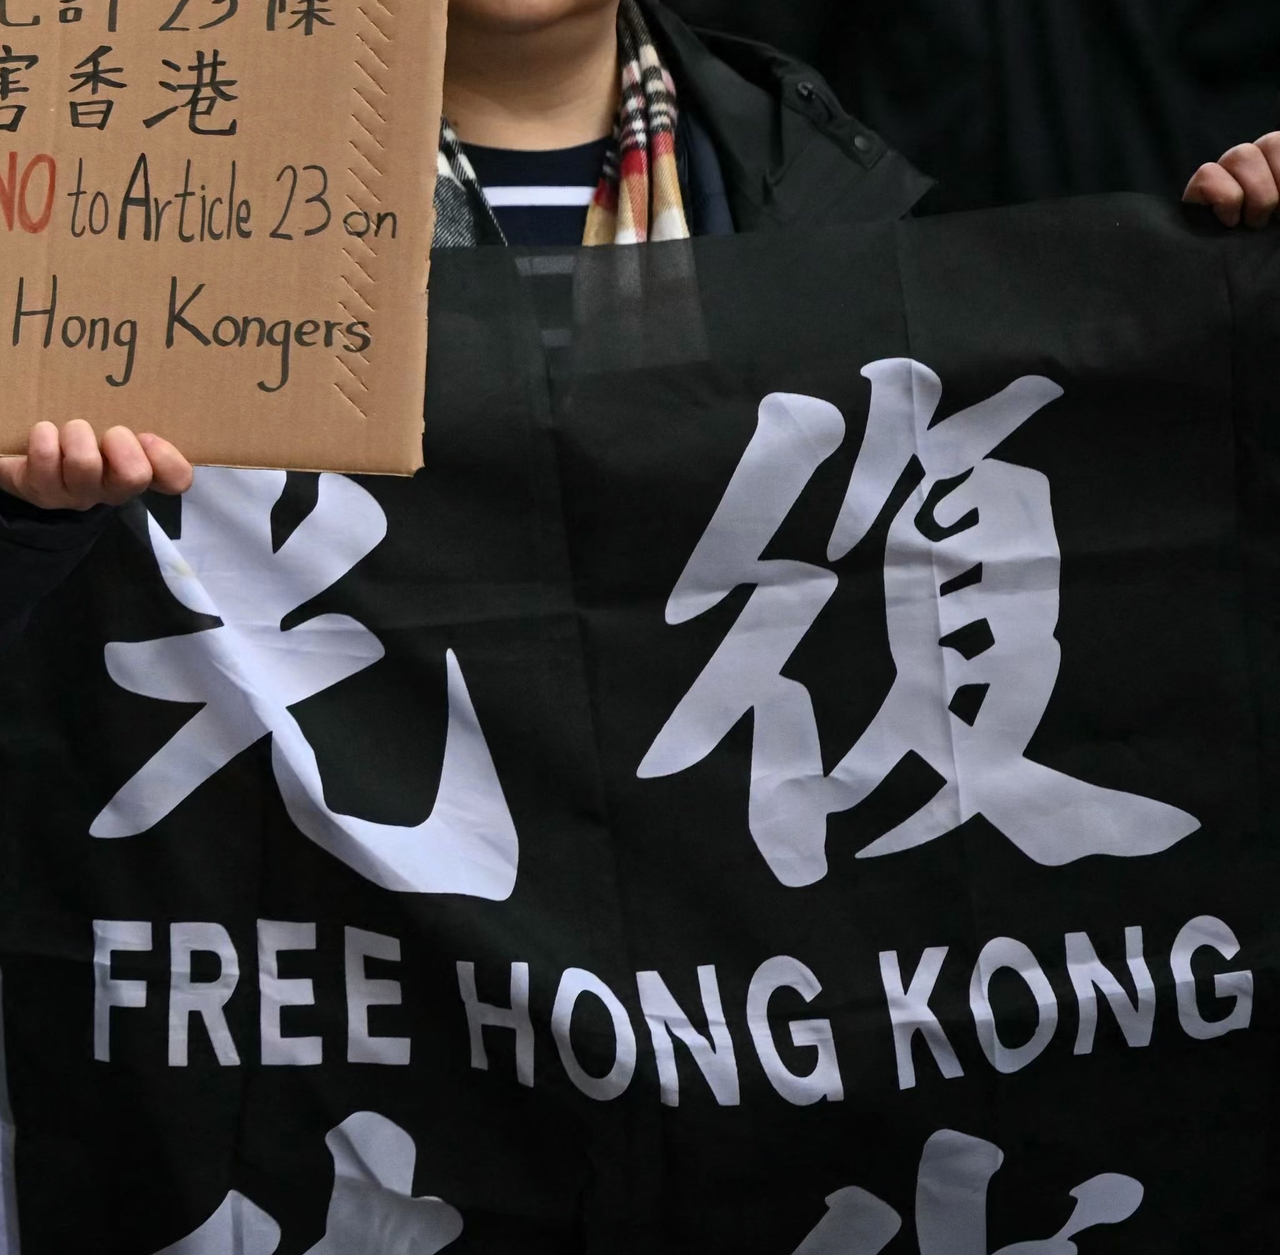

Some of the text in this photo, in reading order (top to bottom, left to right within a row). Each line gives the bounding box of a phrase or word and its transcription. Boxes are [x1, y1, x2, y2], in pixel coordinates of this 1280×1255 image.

[67, 157, 110, 238] to
[117, 152, 252, 243] Article
[269, 164, 332, 241] 23
[342, 205, 398, 239] on
[13, 274, 138, 387] Hong
[165, 276, 372, 393] Kongers
[91, 915, 1254, 1108] FREE HONG KONG
